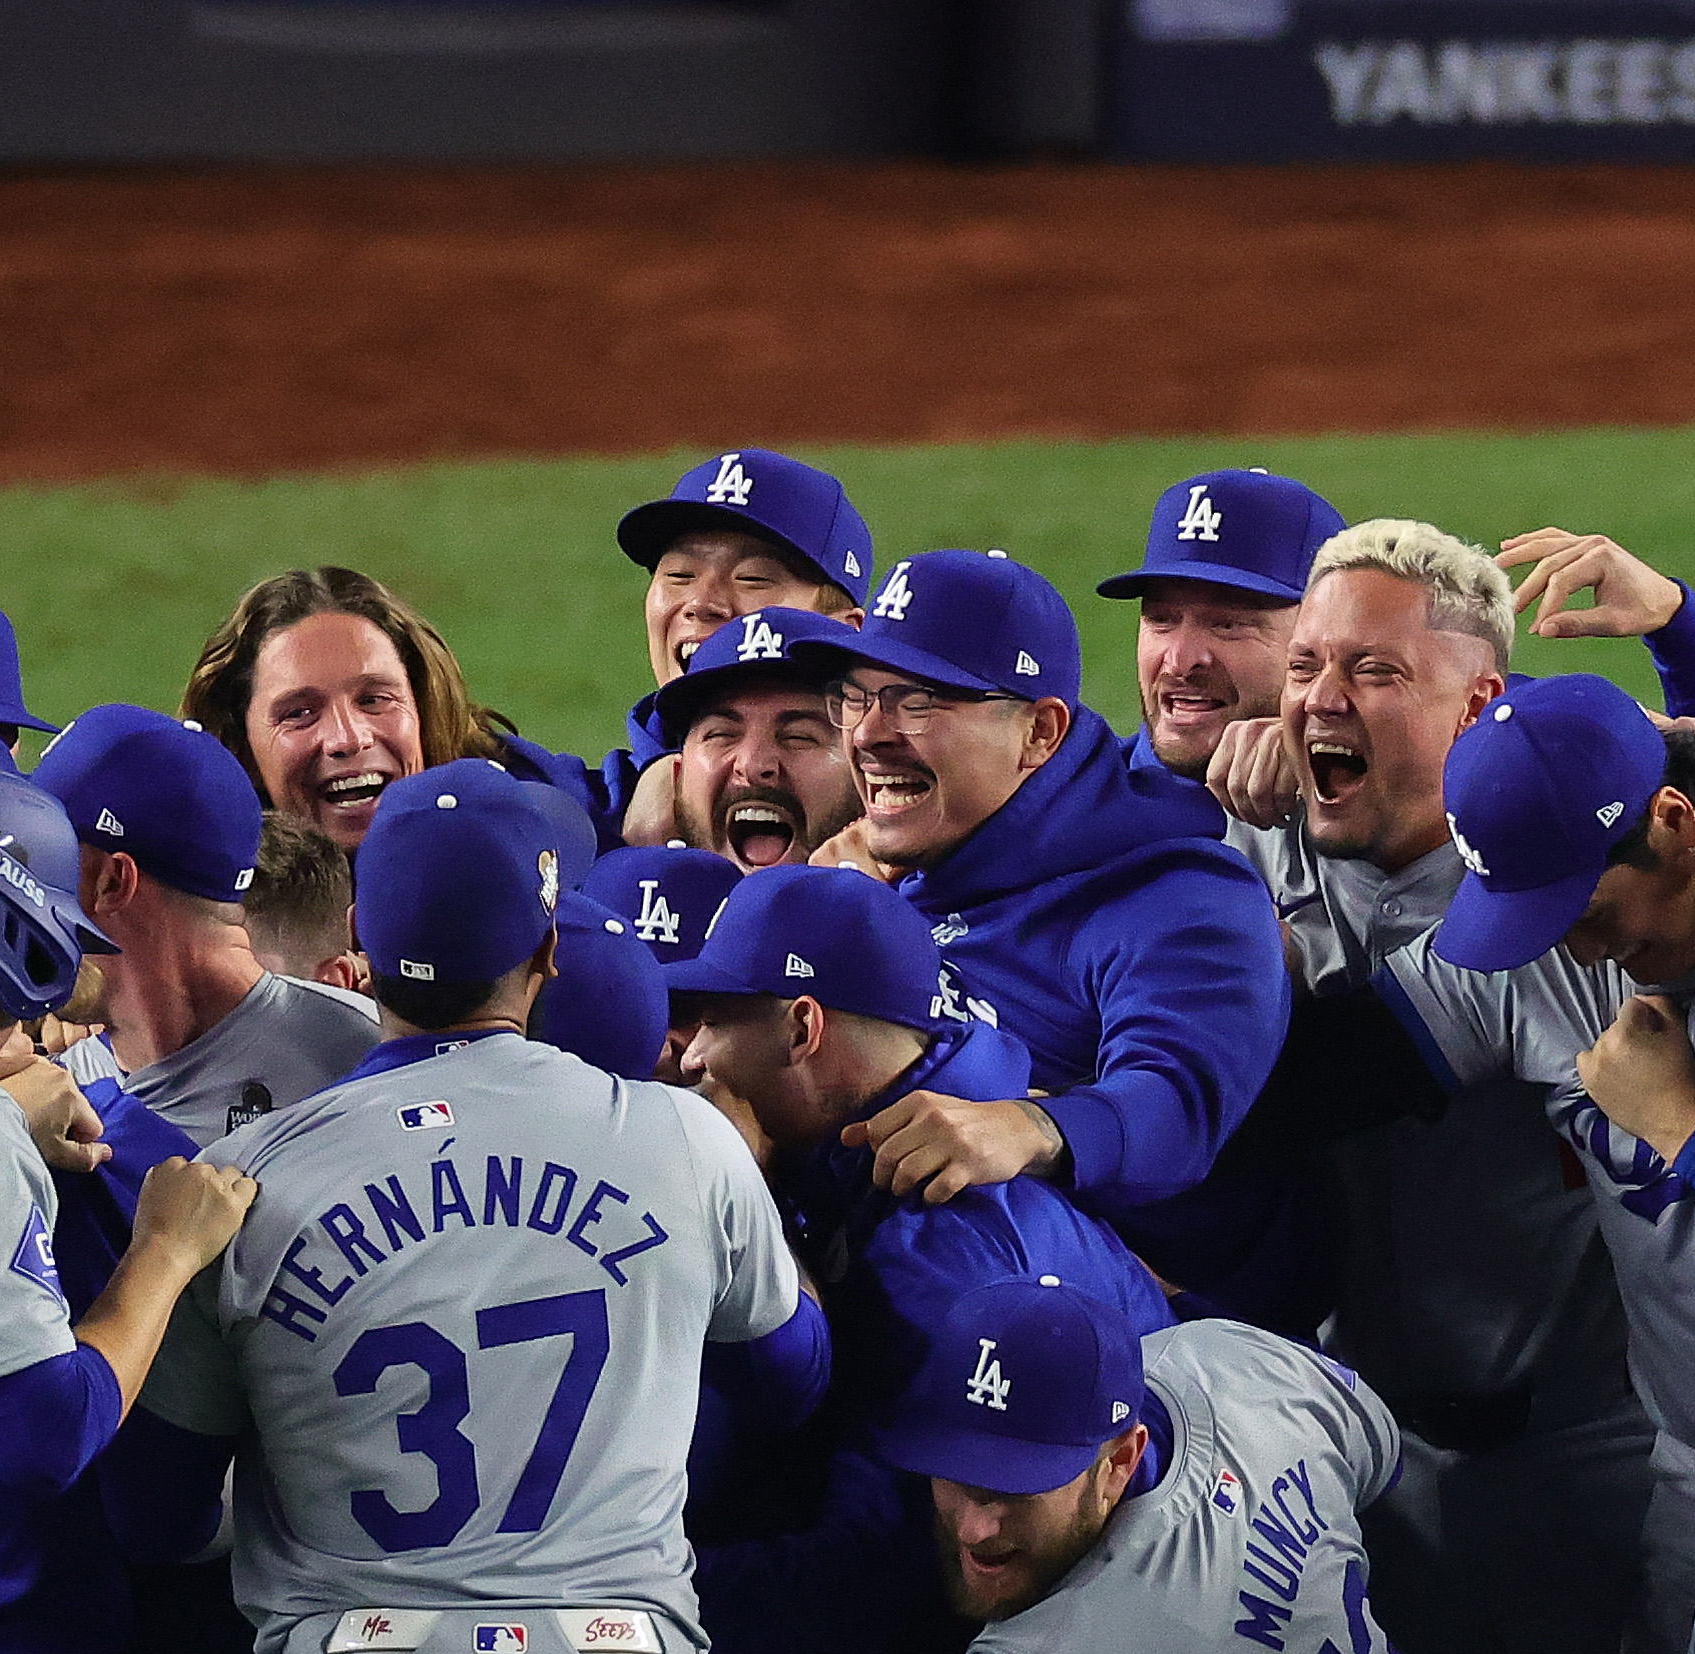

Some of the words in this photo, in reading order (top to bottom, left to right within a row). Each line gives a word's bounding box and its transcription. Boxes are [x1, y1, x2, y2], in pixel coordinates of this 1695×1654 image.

[707, 453, 753, 505] LA
[1177, 486, 1221, 541] LA
[872, 561, 914, 621] LA
[736, 612, 783, 661] LA
[634, 879, 680, 943] LA
[258, 1138, 670, 1343] HERNÁNDEZ
[966, 1338, 1012, 1411] LA
[332, 1288, 610, 1554] 37
[1234, 1458, 1329, 1652] MUNCY
